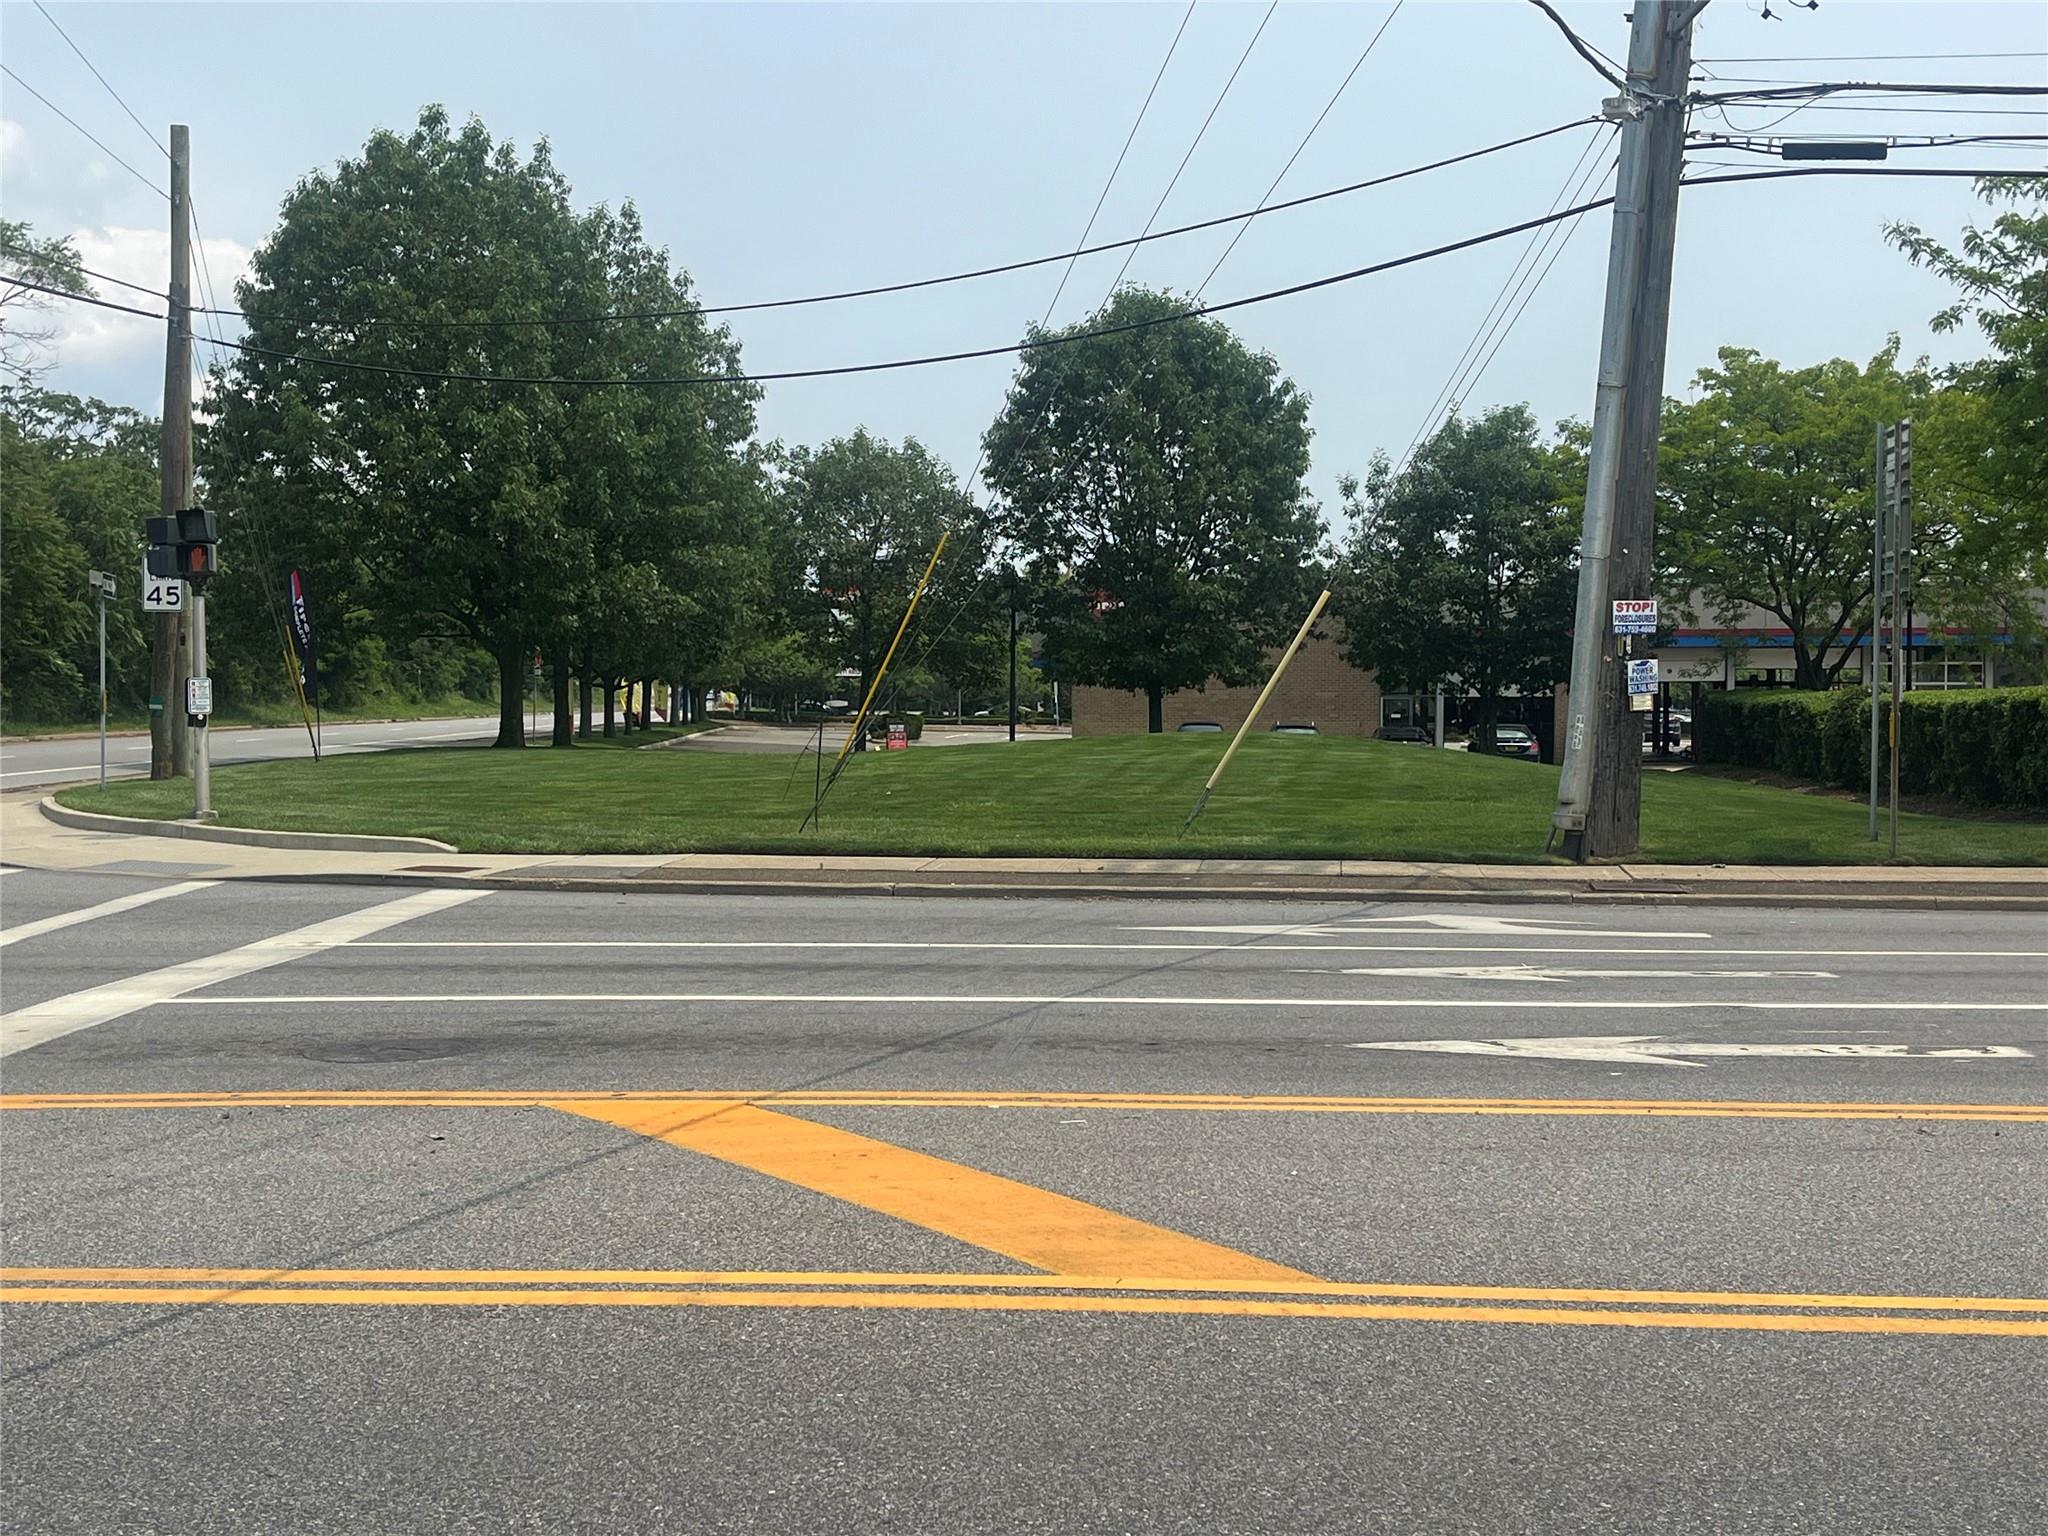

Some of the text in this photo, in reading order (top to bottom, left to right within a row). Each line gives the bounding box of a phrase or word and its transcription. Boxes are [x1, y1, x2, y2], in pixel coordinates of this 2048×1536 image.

[146, 586, 180, 606] 45
[1615, 602, 1654, 613] STOP!
[1615, 614, 1656, 623] FORECLOSURES
[1631, 666, 1654, 675] POWER
[1629, 673, 1658, 683] WASHING
